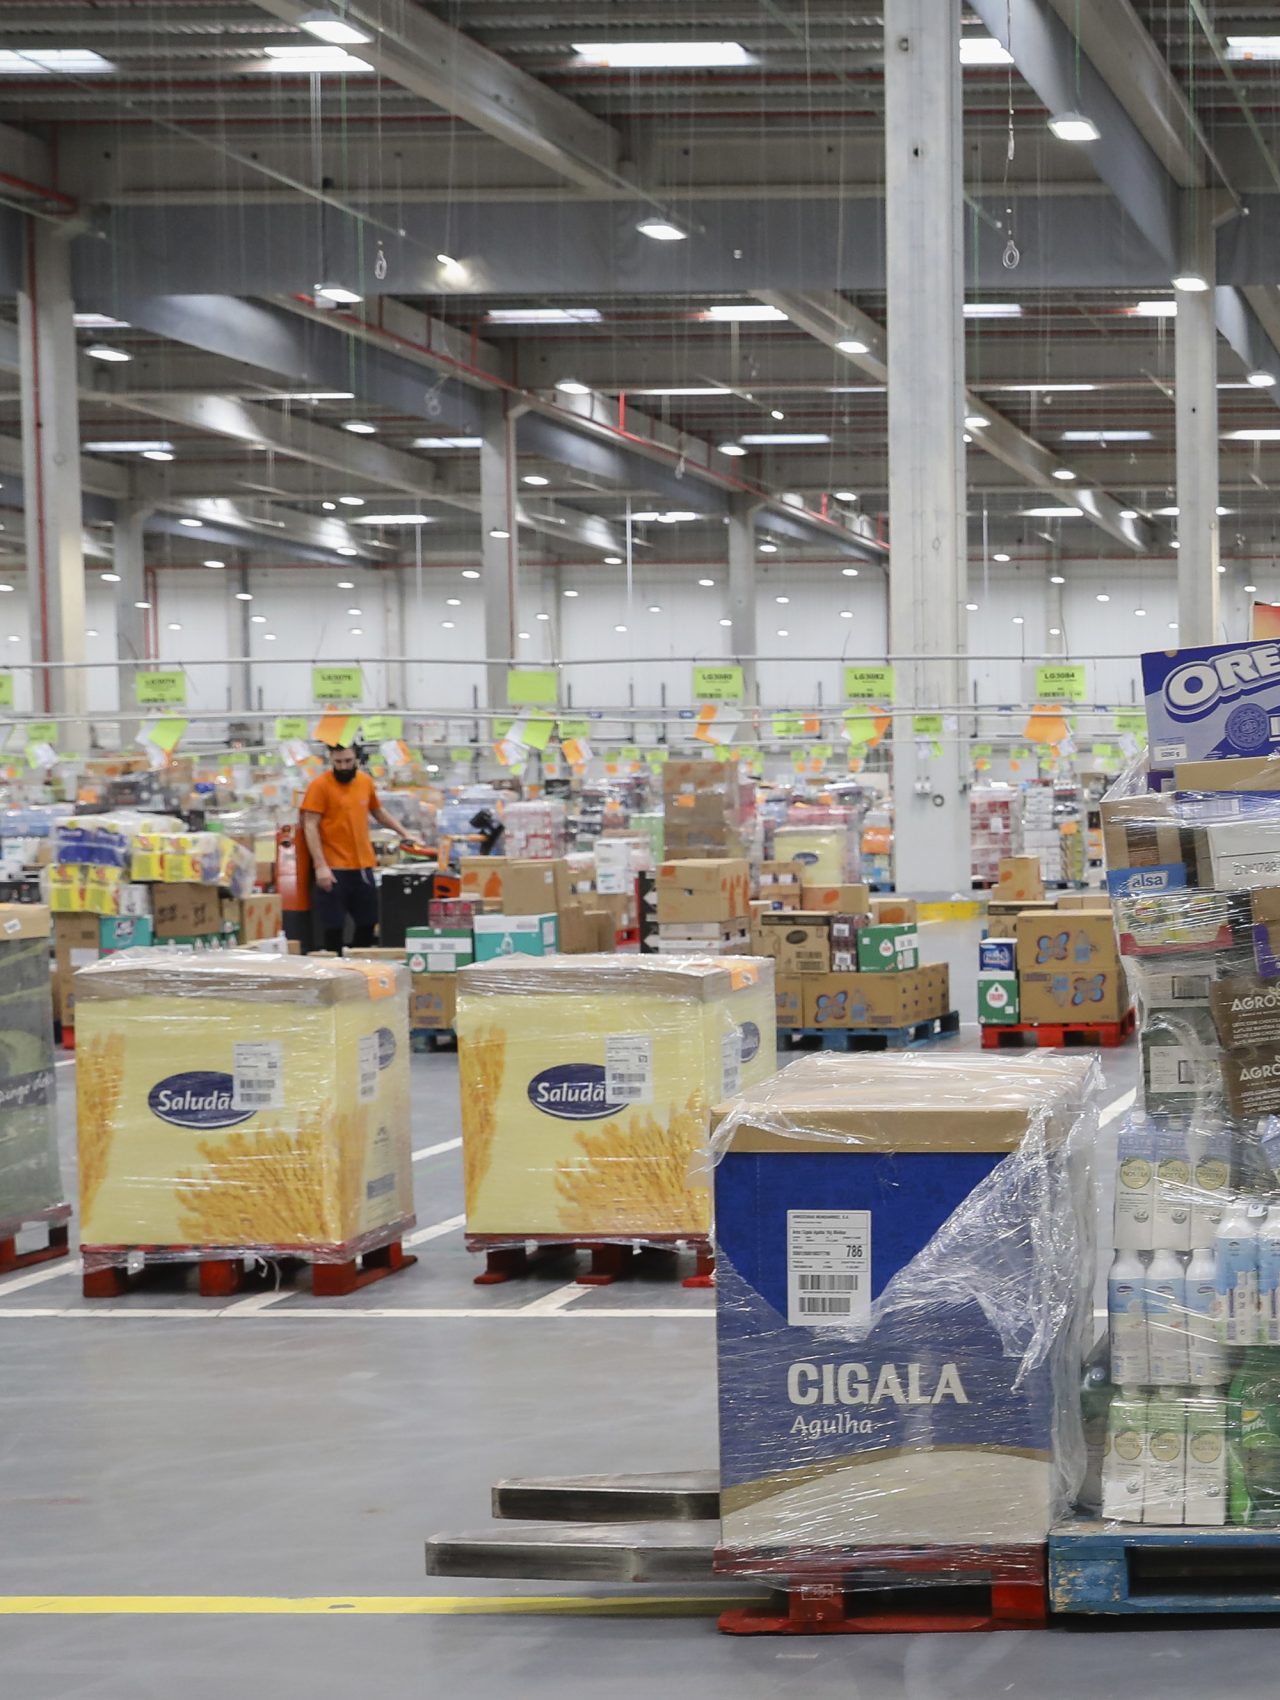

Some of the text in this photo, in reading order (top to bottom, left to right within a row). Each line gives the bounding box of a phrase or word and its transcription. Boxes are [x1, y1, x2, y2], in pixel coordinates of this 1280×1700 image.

[1132, 873, 1164, 889] alsa
[158, 1089, 234, 1112] Saludã
[537, 1082, 606, 1103] Saludã
[846, 1244, 863, 1258] 786
[787, 1362, 968, 1405] CIGALA
[789, 1413, 874, 1436] Agulha
